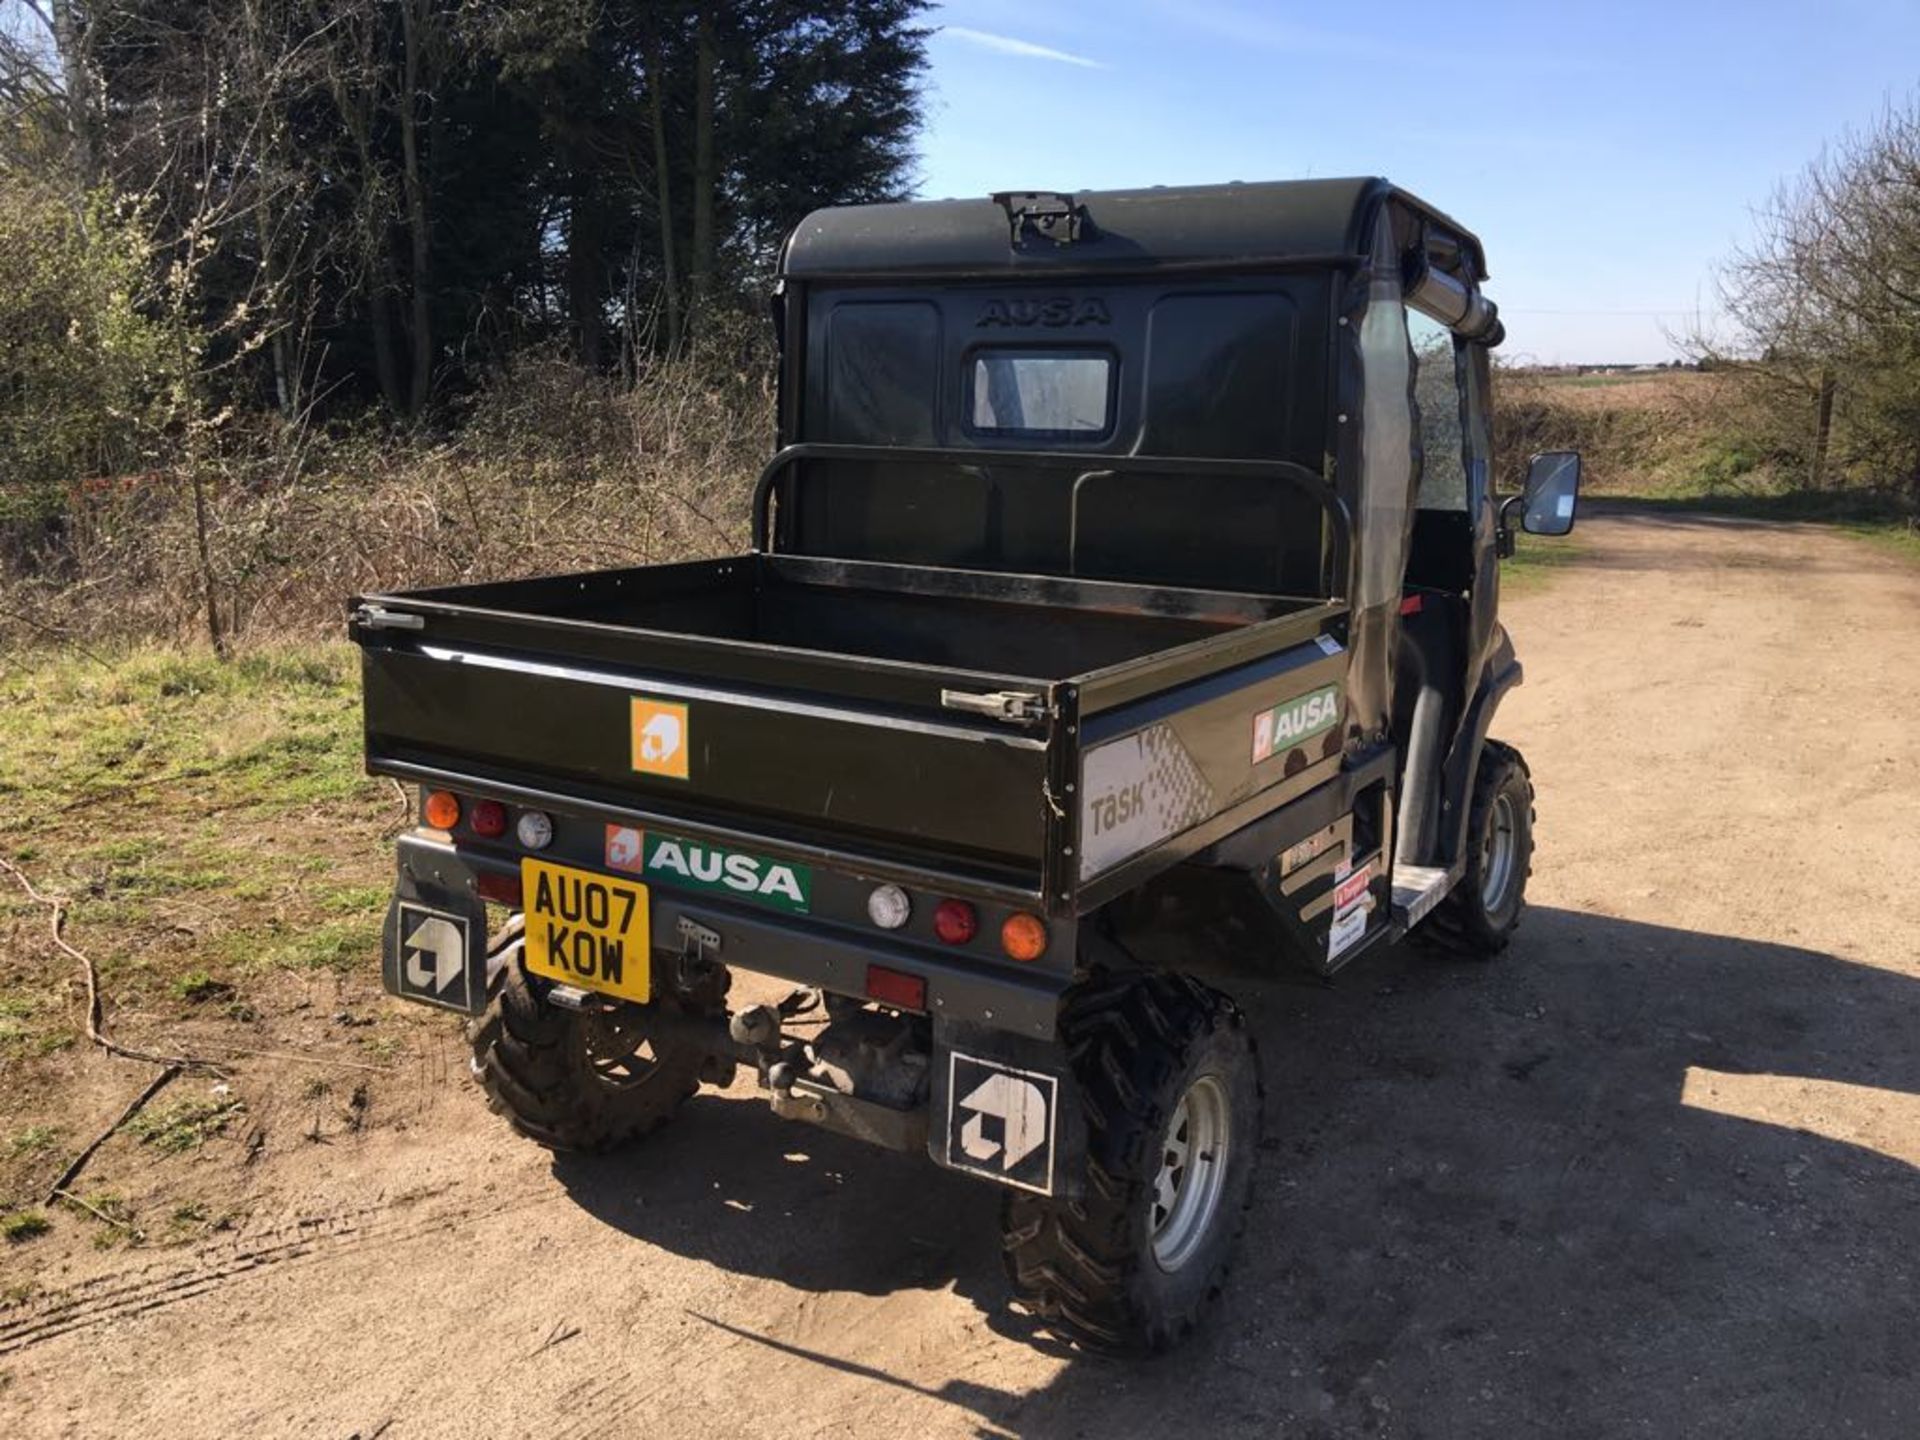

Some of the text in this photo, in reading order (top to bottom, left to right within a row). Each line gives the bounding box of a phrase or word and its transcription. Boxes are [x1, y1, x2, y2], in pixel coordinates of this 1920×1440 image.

[976, 297, 1112, 328] AUSA
[1274, 691, 1338, 742] AUSA
[535, 870, 636, 934] AU07
[649, 841, 805, 903] AUSA
[548, 922, 623, 985] KOW
